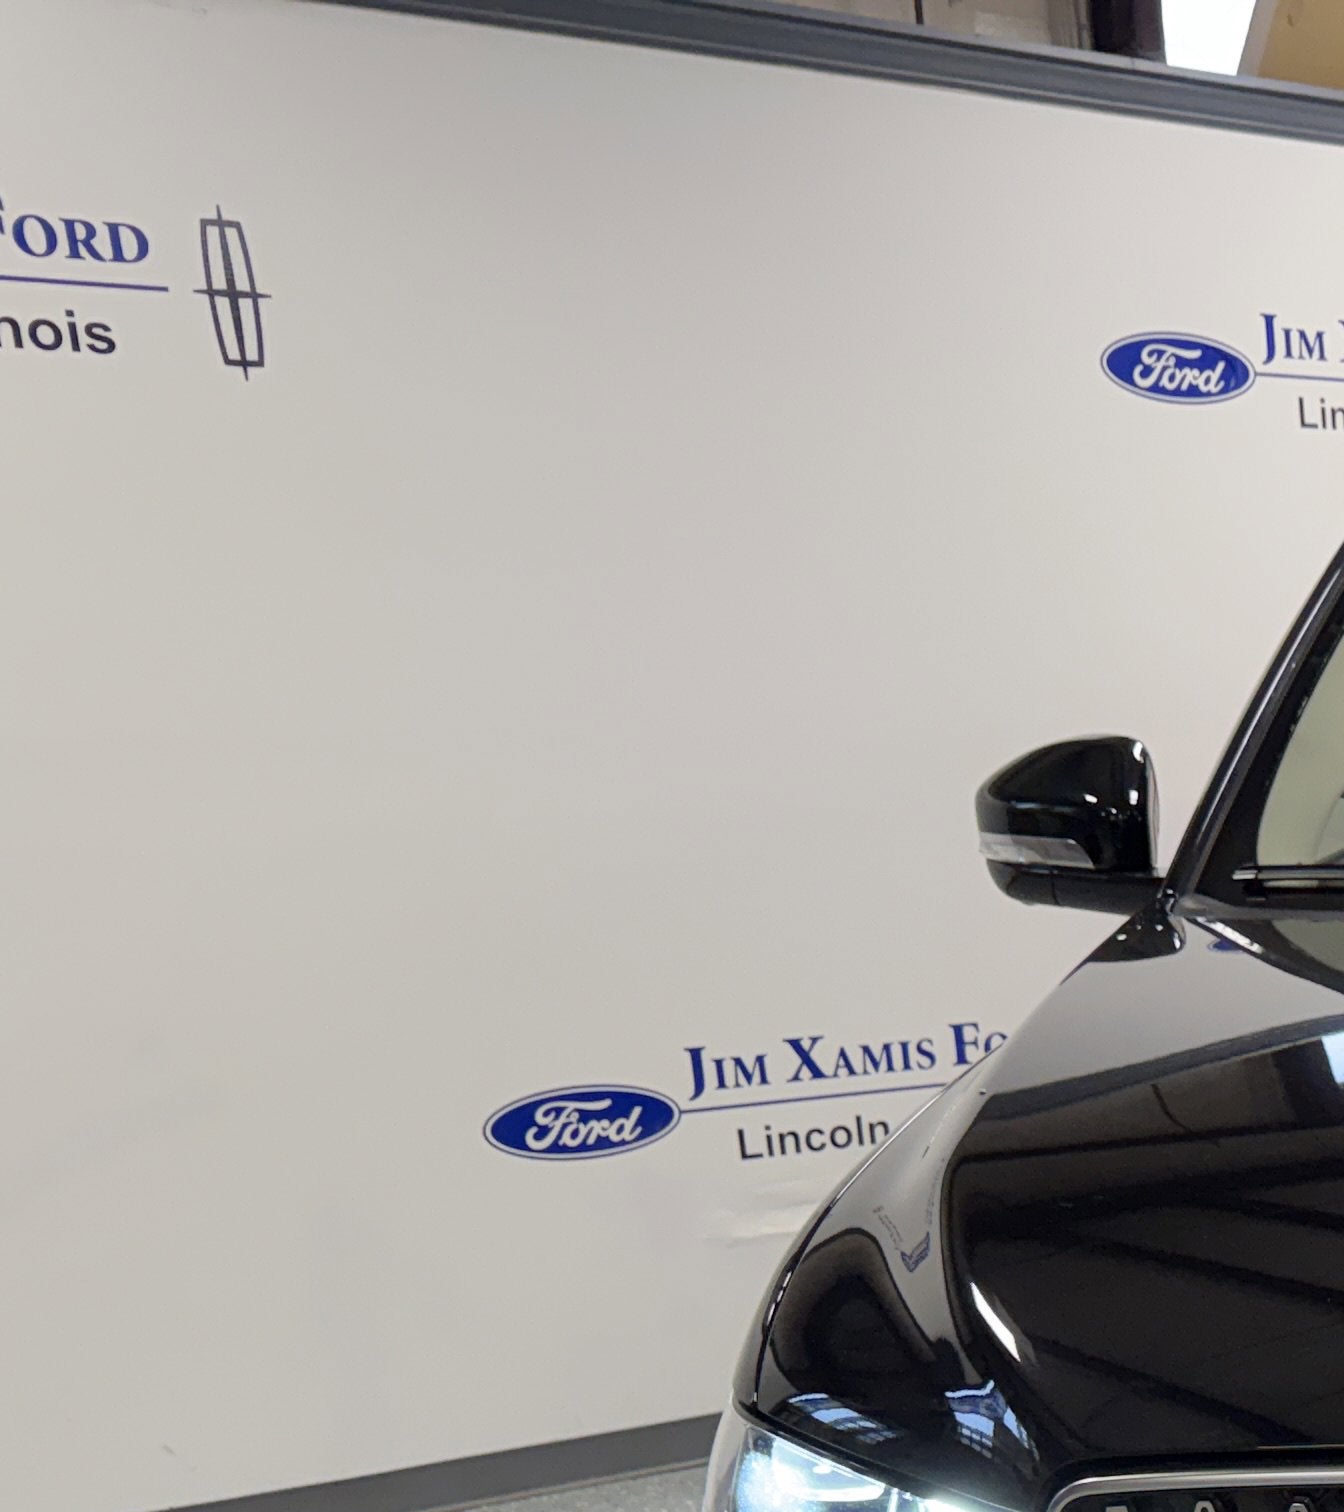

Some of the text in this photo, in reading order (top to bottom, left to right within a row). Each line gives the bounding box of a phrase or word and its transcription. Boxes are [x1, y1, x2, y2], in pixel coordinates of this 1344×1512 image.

[0, 195, 149, 263] ORD
[0, 309, 116, 354] nois
[1260, 314, 1326, 365] JIM
[1133, 343, 1224, 394] Ford
[684, 1046, 768, 1101] JIM
[783, 1036, 937, 1082] XAMIS
[524, 1098, 642, 1150] Ford
